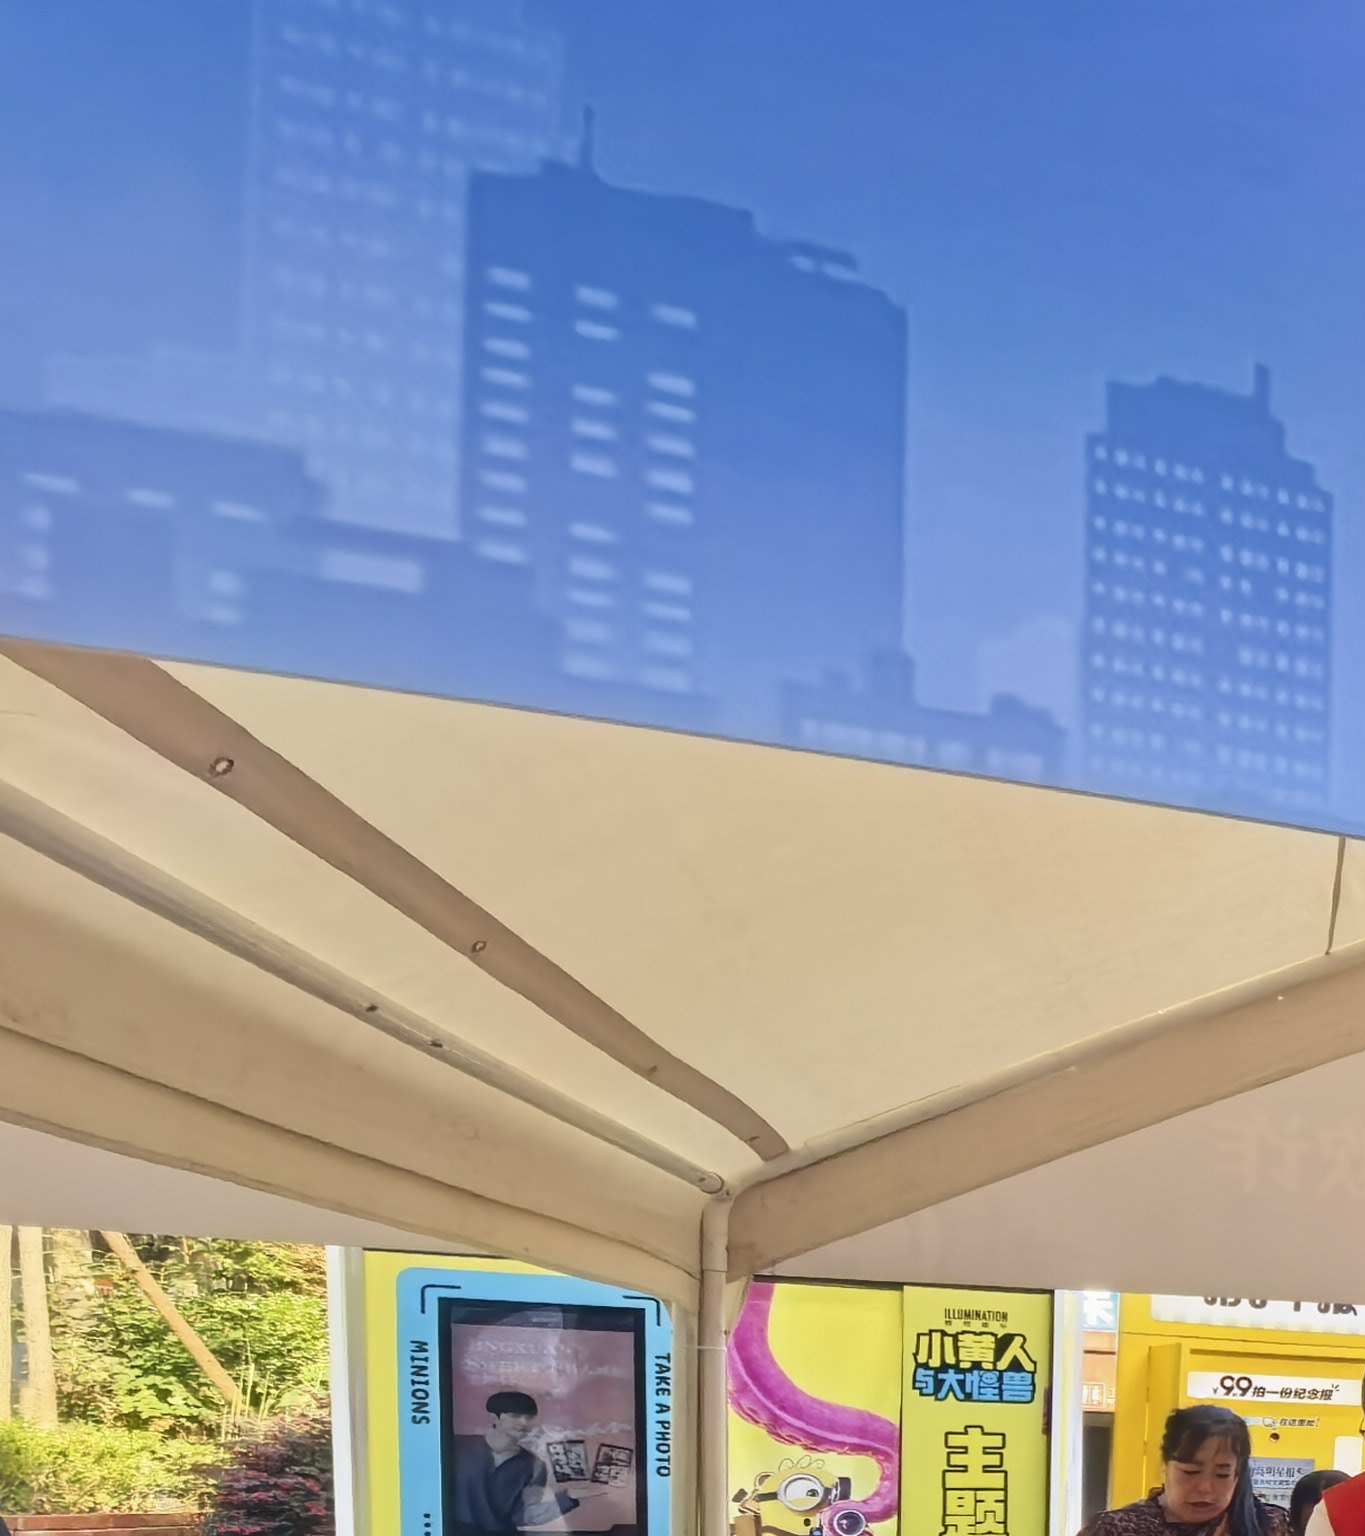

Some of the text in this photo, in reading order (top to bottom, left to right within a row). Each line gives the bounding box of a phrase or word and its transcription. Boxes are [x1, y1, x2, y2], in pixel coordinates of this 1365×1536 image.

[944, 1308, 1008, 1322] ILLUMINATION
[913, 1329, 1037, 1373] 小黄人
[409, 1340, 430, 1425] MINIONS
[914, 1368, 1035, 1403] 与大怪兽
[654, 1352, 671, 1477] TAKE A PHOTO
